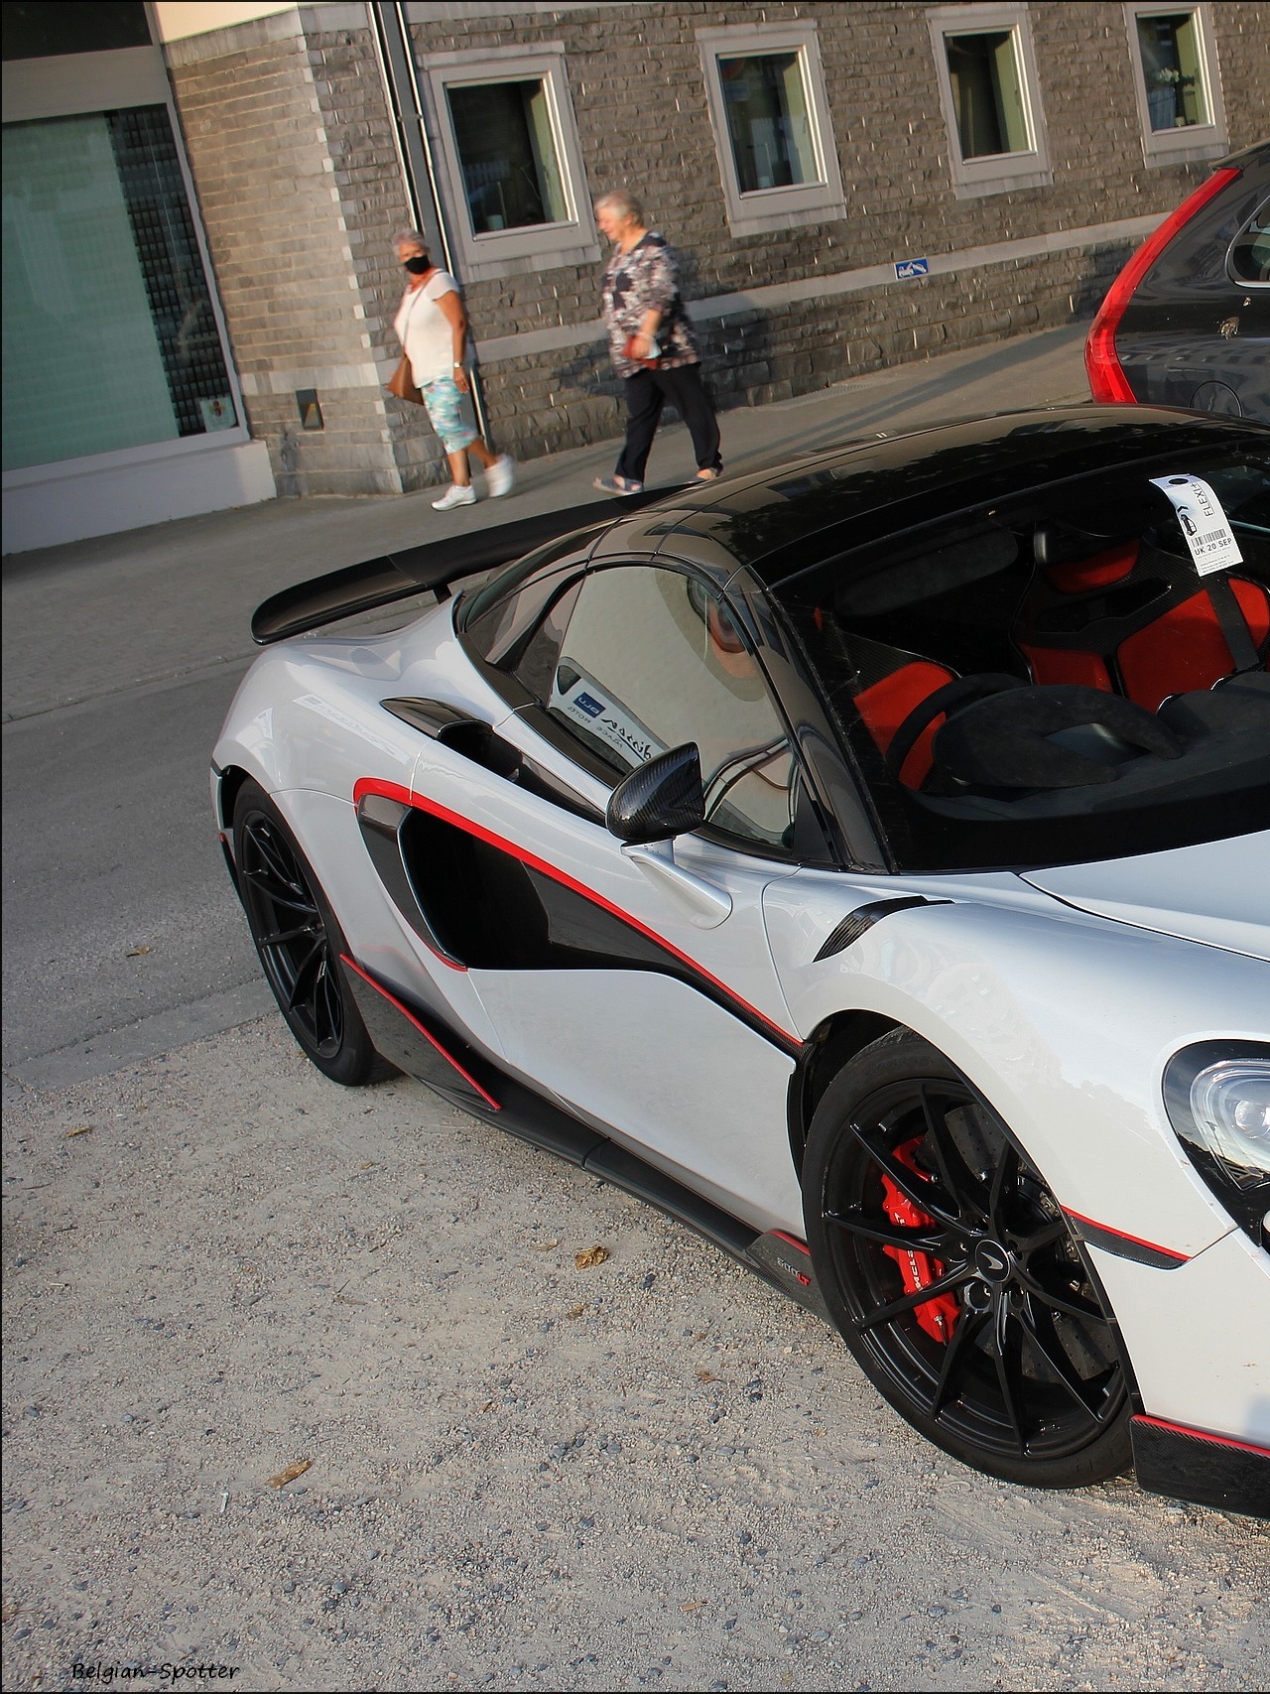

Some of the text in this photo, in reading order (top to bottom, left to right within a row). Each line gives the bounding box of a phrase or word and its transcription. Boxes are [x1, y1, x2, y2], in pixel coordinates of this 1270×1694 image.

[1194, 546, 1205, 556] UK
[1208, 543, 1217, 552] 20
[1219, 538, 1232, 548] SEP
